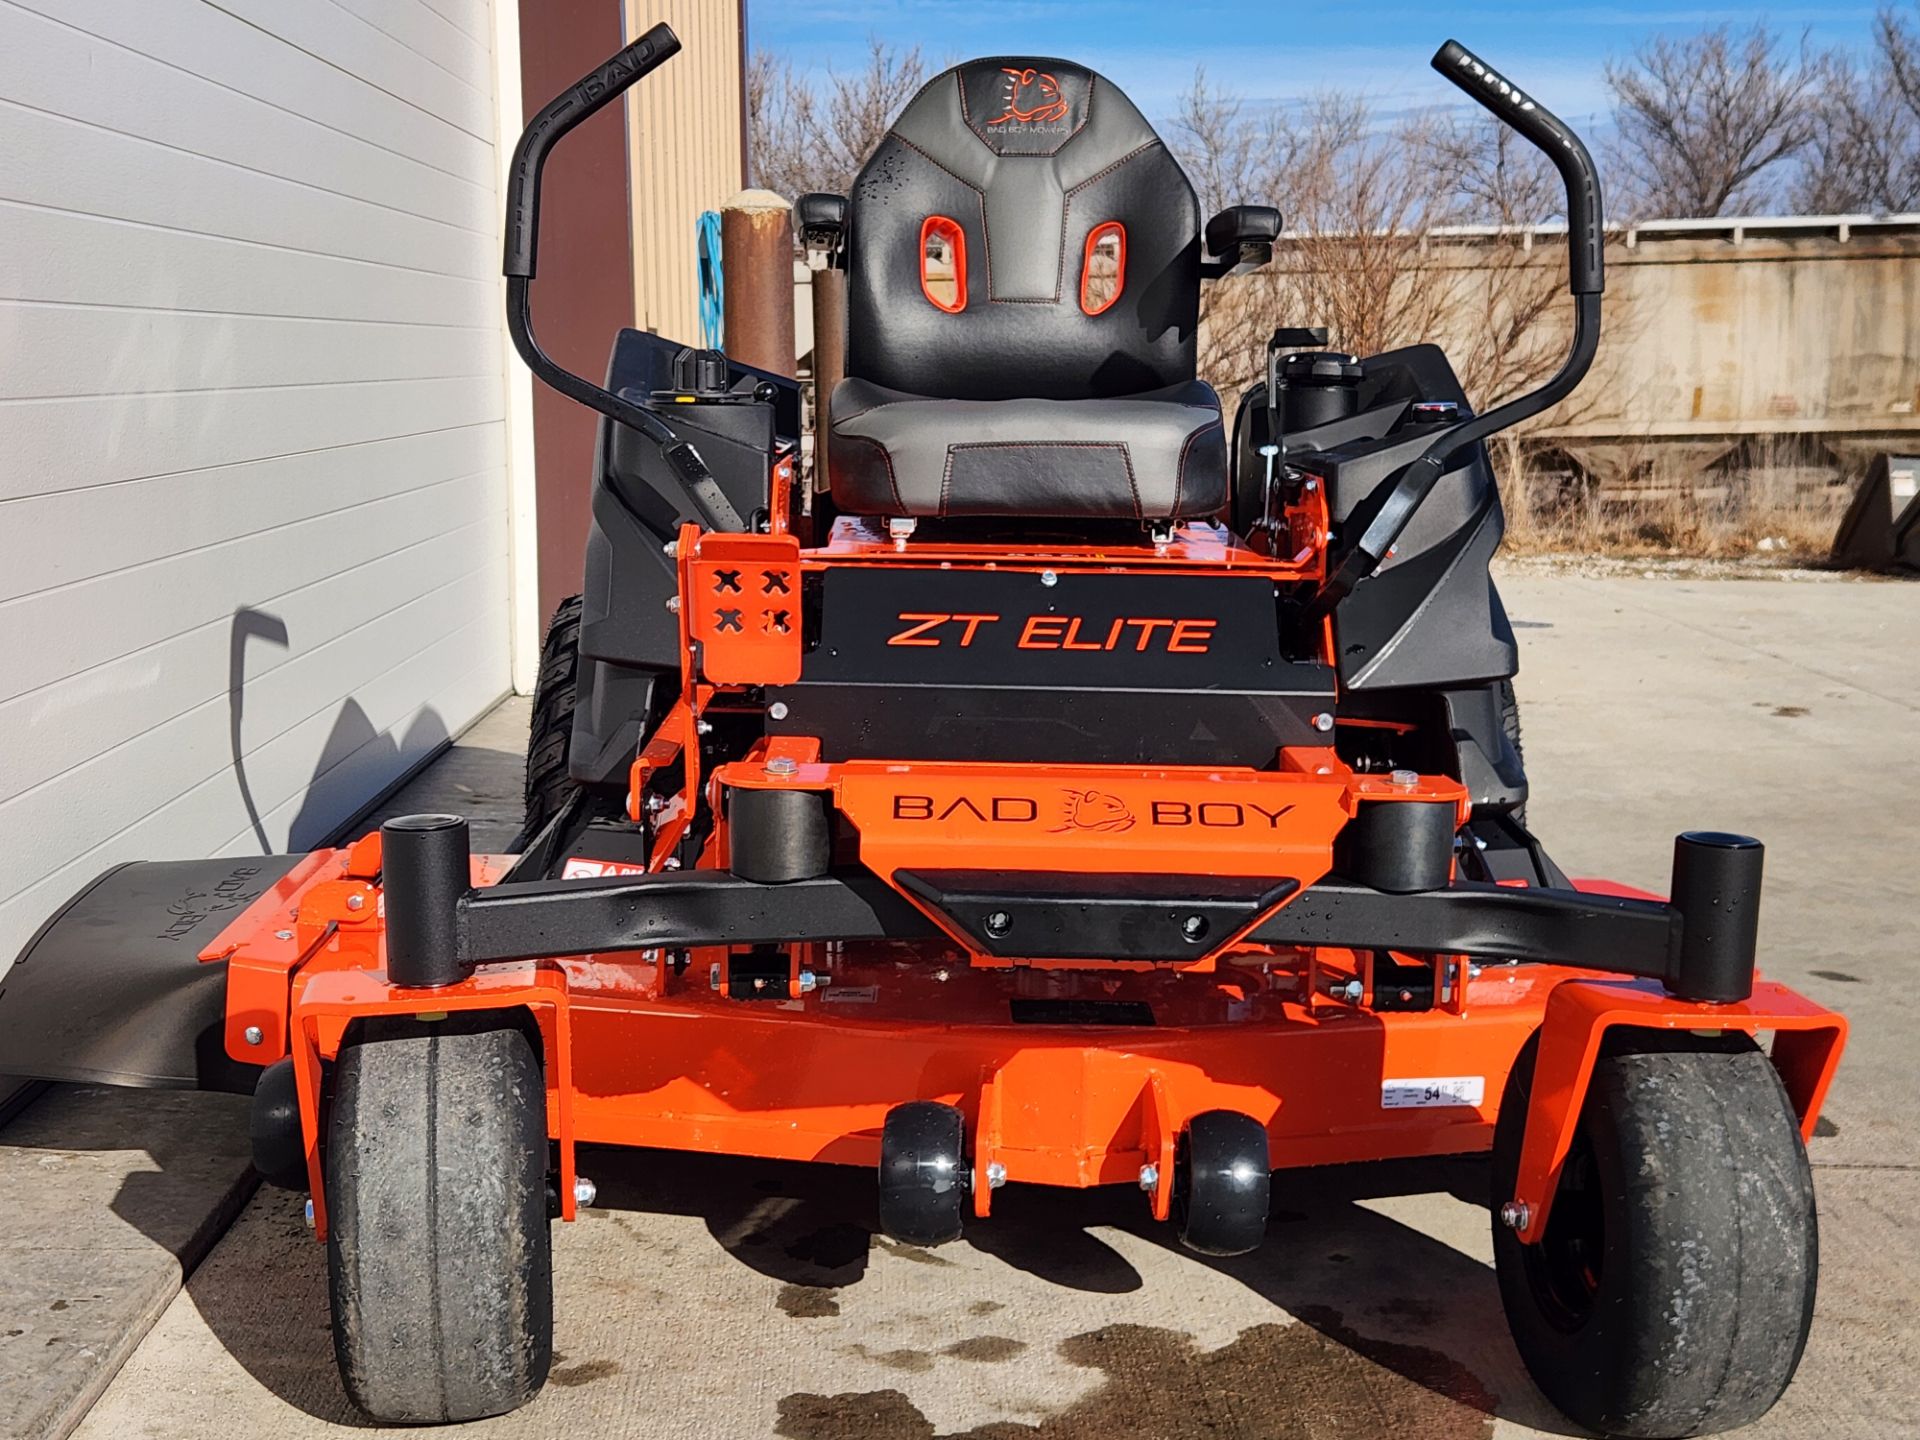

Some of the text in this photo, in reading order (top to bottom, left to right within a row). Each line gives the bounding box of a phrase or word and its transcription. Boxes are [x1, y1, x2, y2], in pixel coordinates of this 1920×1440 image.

[576, 39, 654, 105] BAD
[987, 126, 1006, 135] BAD
[1008, 126, 1027, 135] BOY
[887, 614, 1217, 652] ZT ELITE
[892, 795, 1297, 829] BAD BOY
